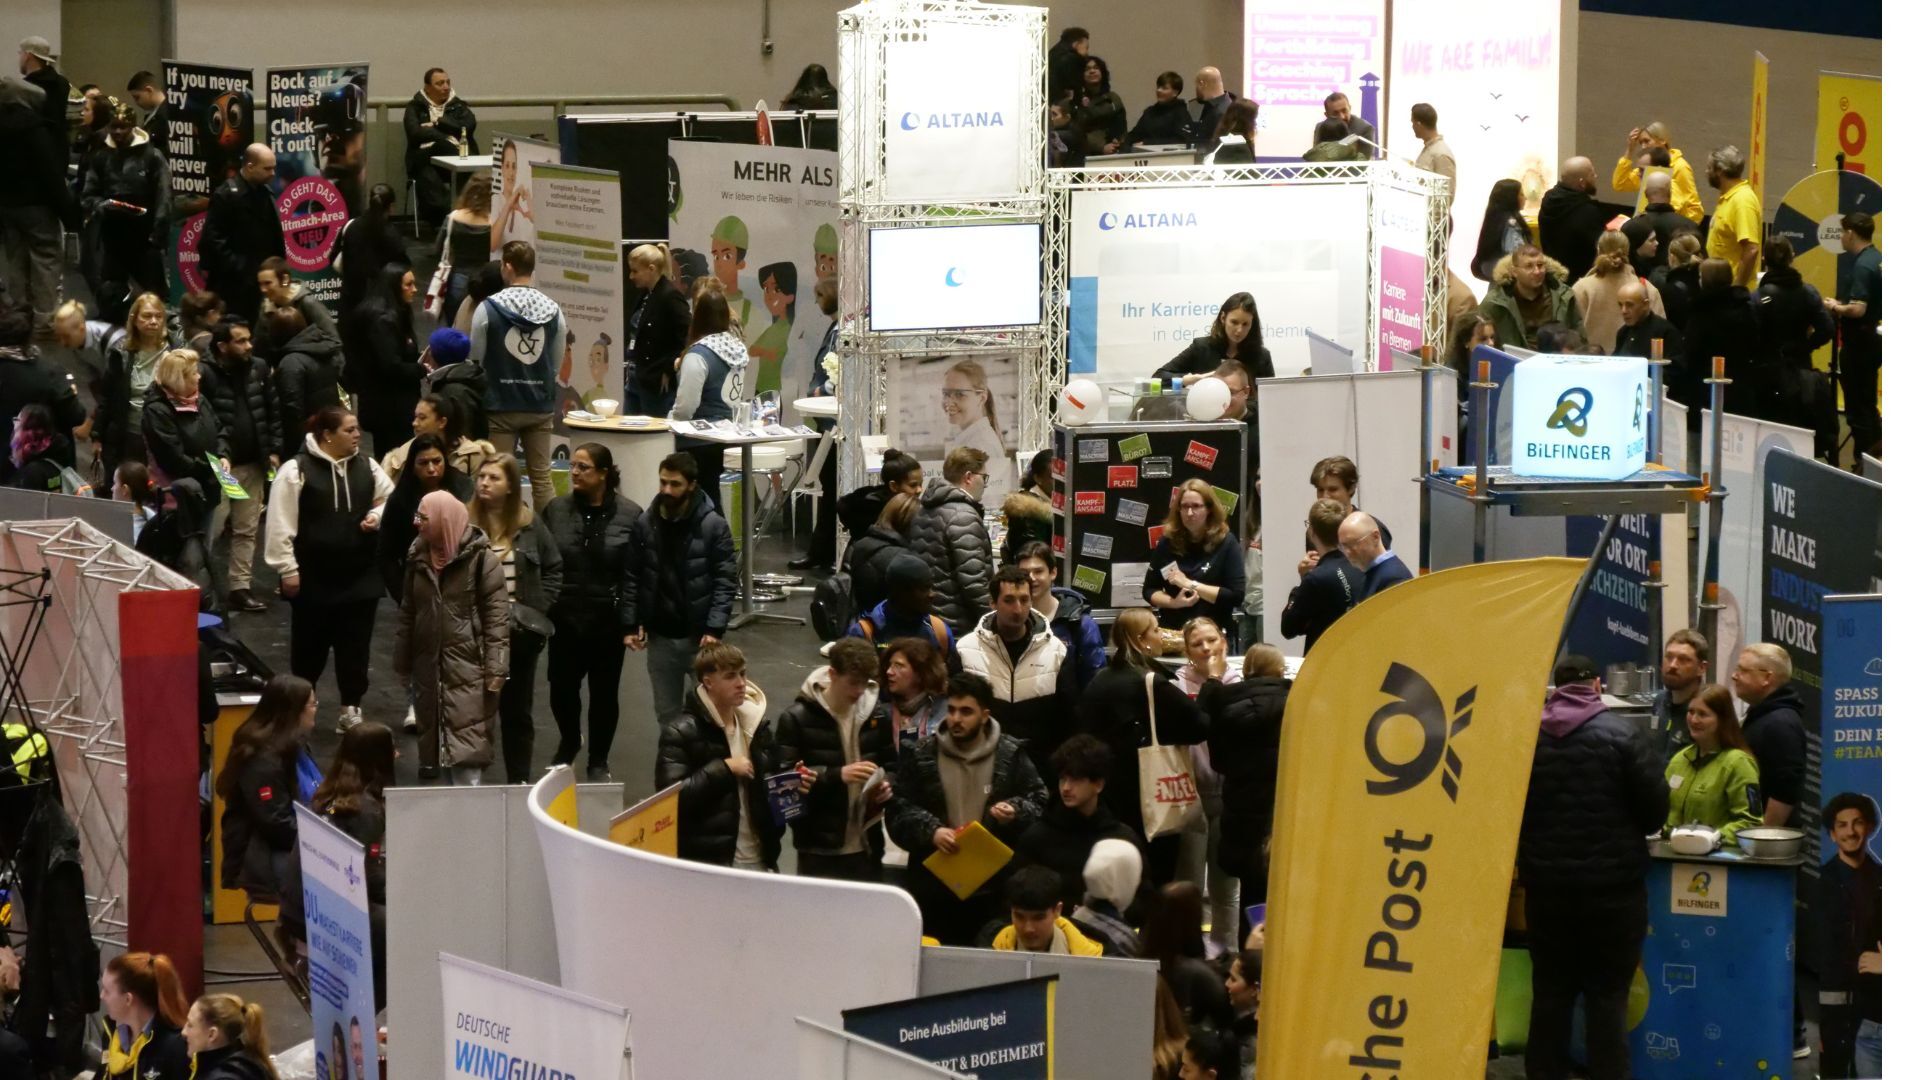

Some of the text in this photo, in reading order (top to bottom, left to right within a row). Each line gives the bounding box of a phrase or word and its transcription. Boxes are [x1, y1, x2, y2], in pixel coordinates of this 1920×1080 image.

[1401, 40, 1432, 76] WE
[1440, 42, 1474, 72] ARE
[166, 67, 249, 92] If you never
[271, 70, 333, 90] Bock auf
[1255, 60, 1346, 82] Coaching
[167, 88, 188, 110] try
[270, 90, 322, 108] Neues?
[168, 120, 193, 138] you
[270, 116, 314, 135] Check
[927, 112, 1004, 128] ALTANA
[168, 137, 194, 155] will
[270, 134, 316, 153] it out!
[169, 158, 207, 174] never
[733, 160, 833, 187] MEHR ALS
[279, 182, 338, 215] SO GEHT DAS!
[720, 190, 734, 200] Wir
[756, 193, 767, 202] die
[1124, 212, 1198, 228] ALTANA
[183, 218, 206, 246] SO GE
[299, 228, 324, 244] NEU
[1383, 279, 1407, 301] Karriere
[1122, 301, 1219, 318] Ihr Karriere
[1382, 304, 1421, 330] mit Zukunft
[1153, 326, 1168, 342] in
[1172, 325, 1198, 341] der
[1382, 328, 1412, 351] in Bremen
[1123, 447, 1147, 461] BÜRO?
[1113, 480, 1136, 488] PLATZ.
[1771, 482, 1796, 518] WE
[1771, 525, 1816, 569] MAKE
[1624, 542, 1651, 577] ORT.
[1074, 579, 1098, 592] BÜRO?
[1771, 608, 1817, 654] WORK
[1834, 687, 1879, 701] SPASS
[1834, 729, 1873, 742] DEIN
[304, 889, 318, 926] DU
[1364, 829, 1433, 973] Post
[456, 1012, 511, 1044] DEUTSCHE
[899, 1011, 1007, 1043] Deine Ausbildung bei
[959, 1057, 968, 1071] &
[970, 1041, 1046, 1069] BOEHMERT
